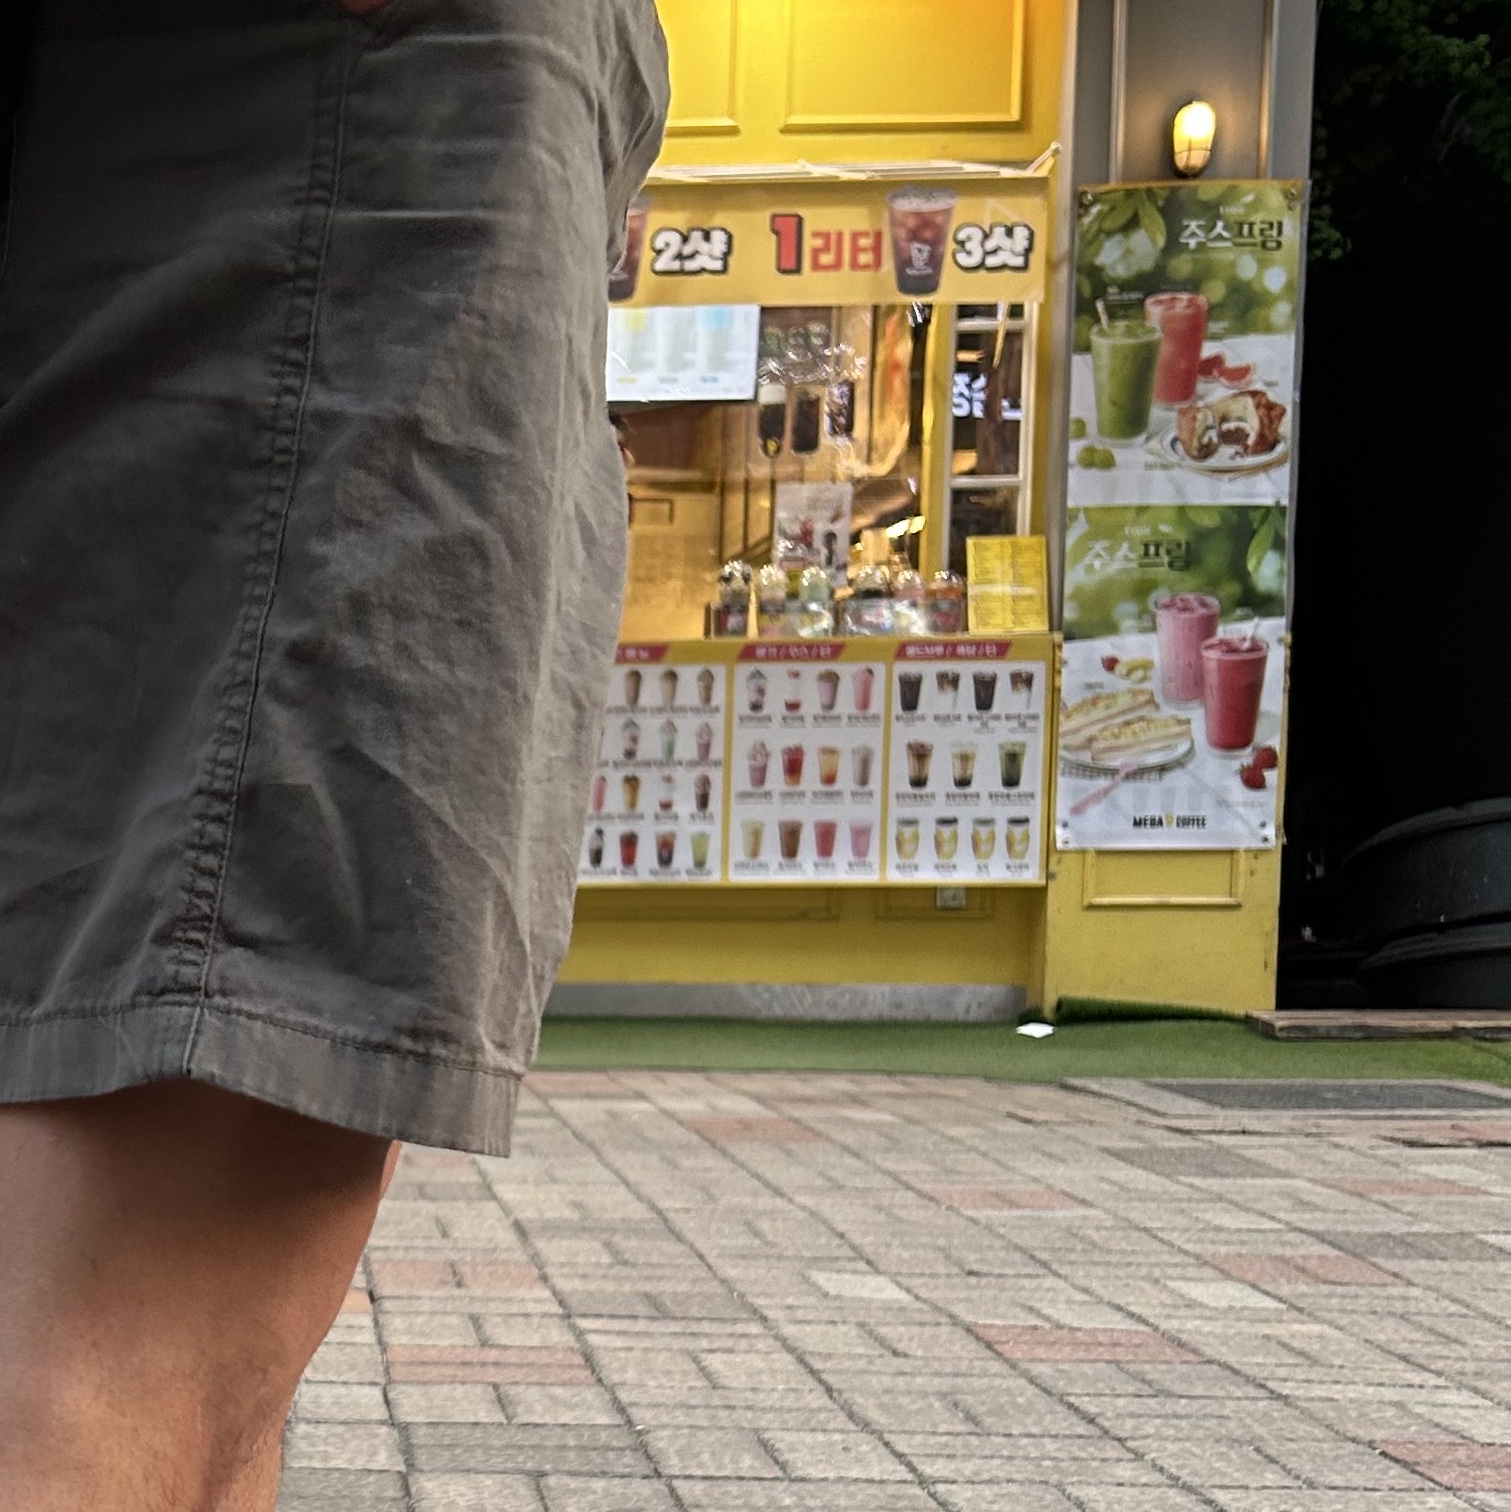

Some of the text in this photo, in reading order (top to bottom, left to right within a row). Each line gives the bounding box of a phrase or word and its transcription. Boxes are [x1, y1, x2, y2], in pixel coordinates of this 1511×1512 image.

[651, 227, 732, 277] 2샷
[953, 222, 1034, 273] 3샷
[1179, 219, 1284, 252] 주스프링
[1085, 540, 1192, 571] 주스프링
[1175, 814, 1208, 829] COFFEE
